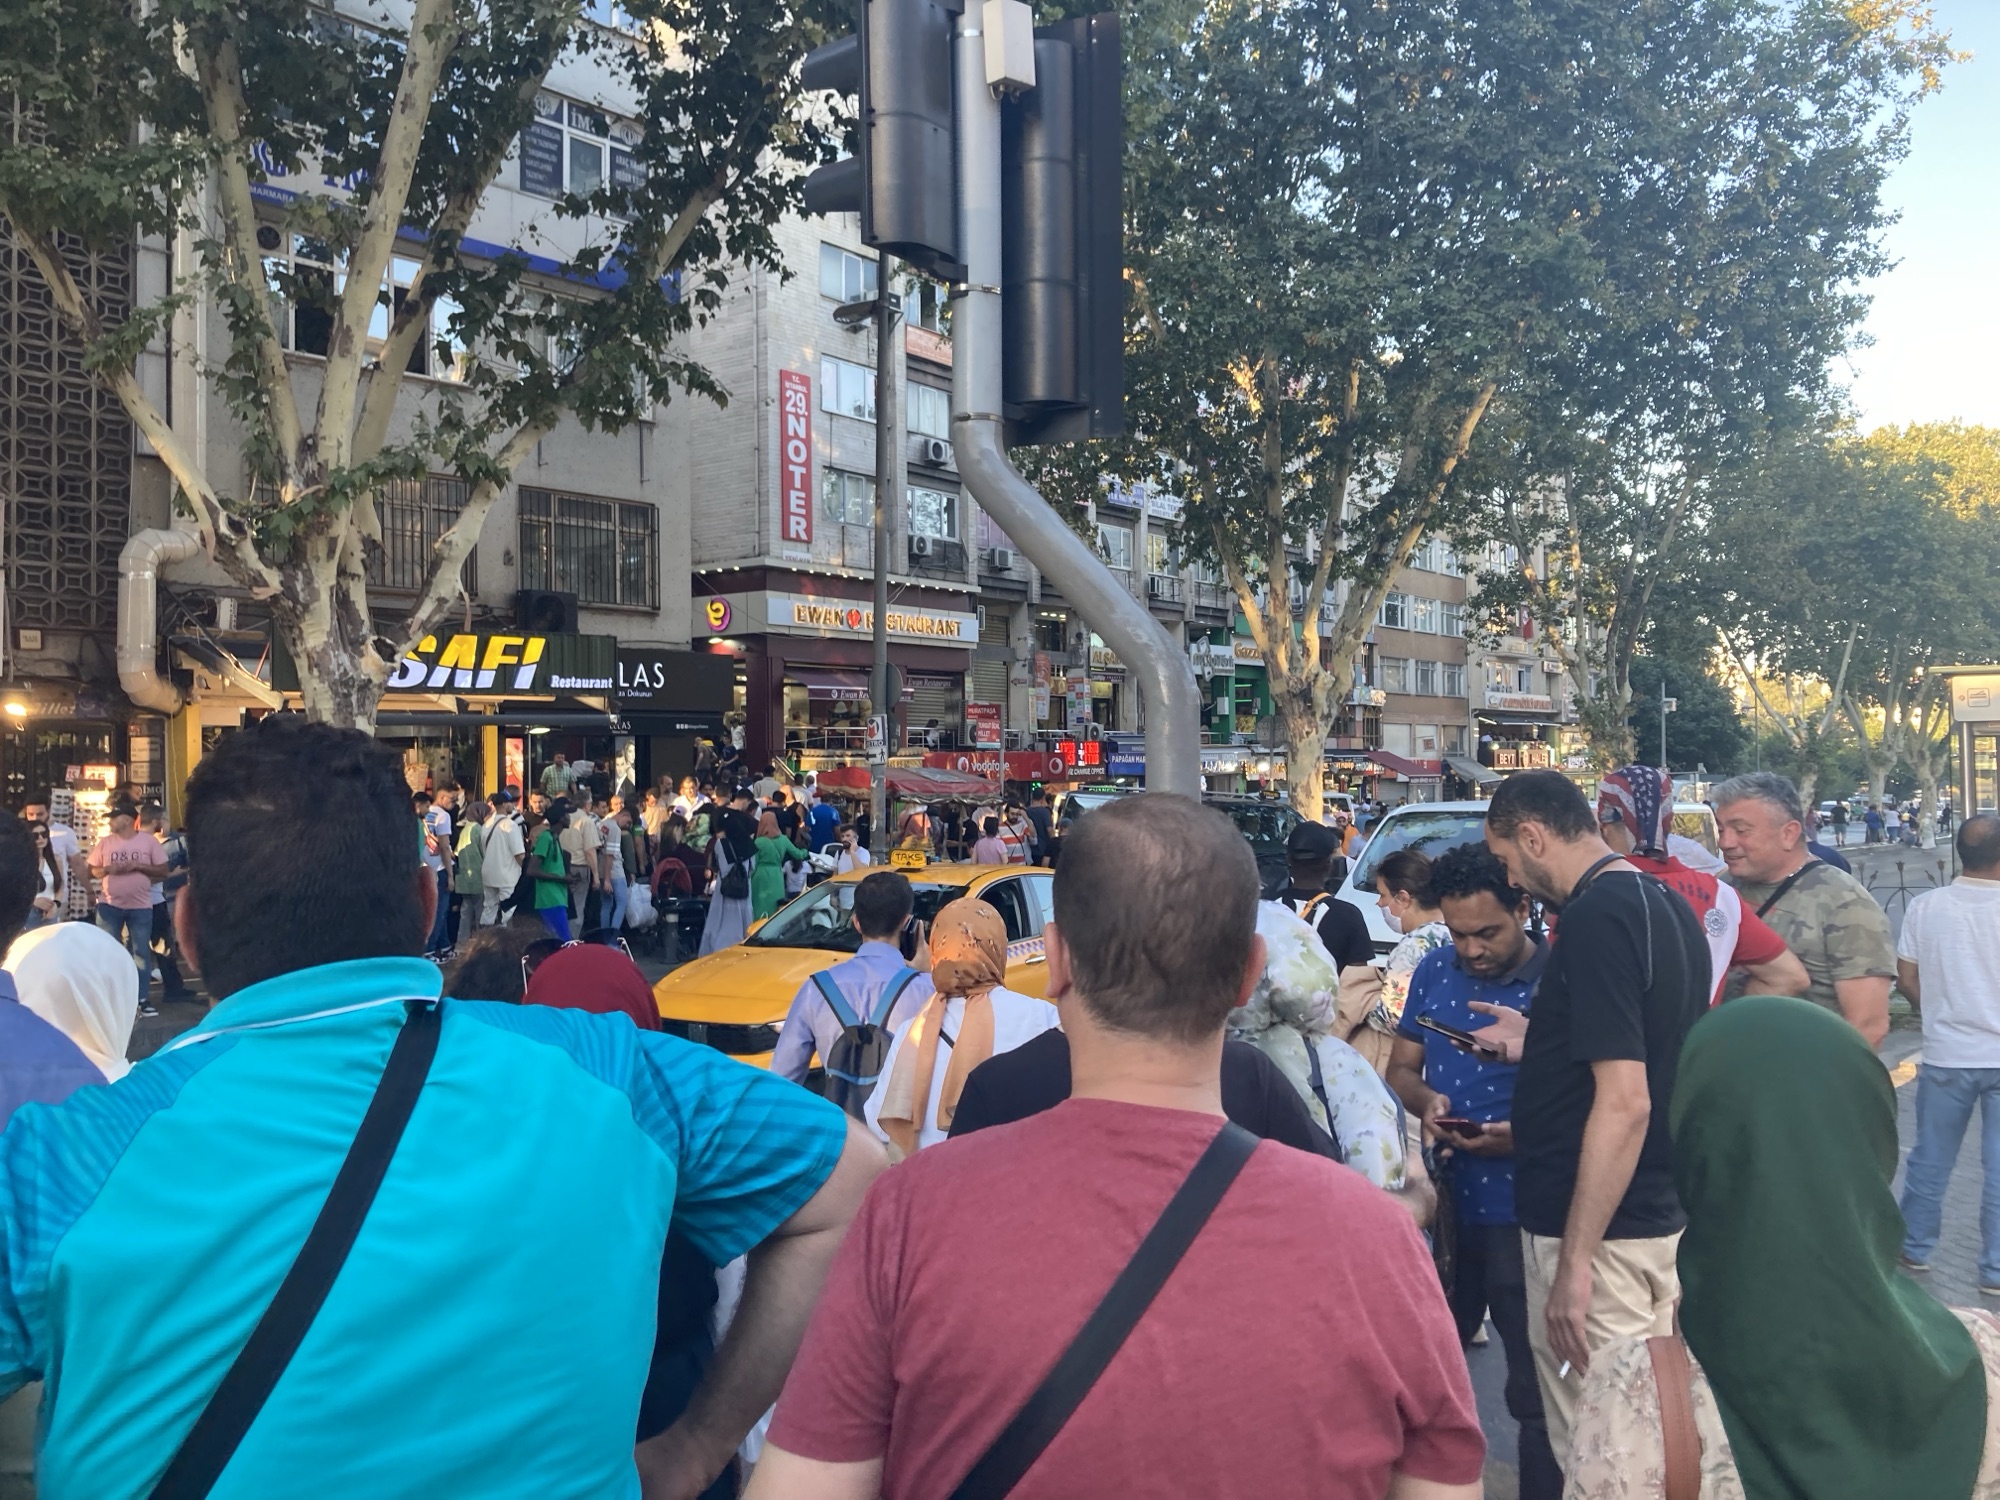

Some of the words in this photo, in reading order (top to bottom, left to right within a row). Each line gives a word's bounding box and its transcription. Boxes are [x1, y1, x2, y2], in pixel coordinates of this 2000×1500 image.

[785, 390, 808, 416] 29.
[787, 415, 808, 541] NOTER
[794, 603, 844, 627] EWAN
[863, 611, 963, 637] RSTAURANT
[388, 634, 546, 690] SAFI
[550, 675, 613, 690] Restaurant
[840, 689, 858, 699] Ewan
[971, 760, 1010, 772] vodafoe
[1111, 754, 1135, 763] PAPAĞAN
[1499, 753, 1515, 765] BEYT
